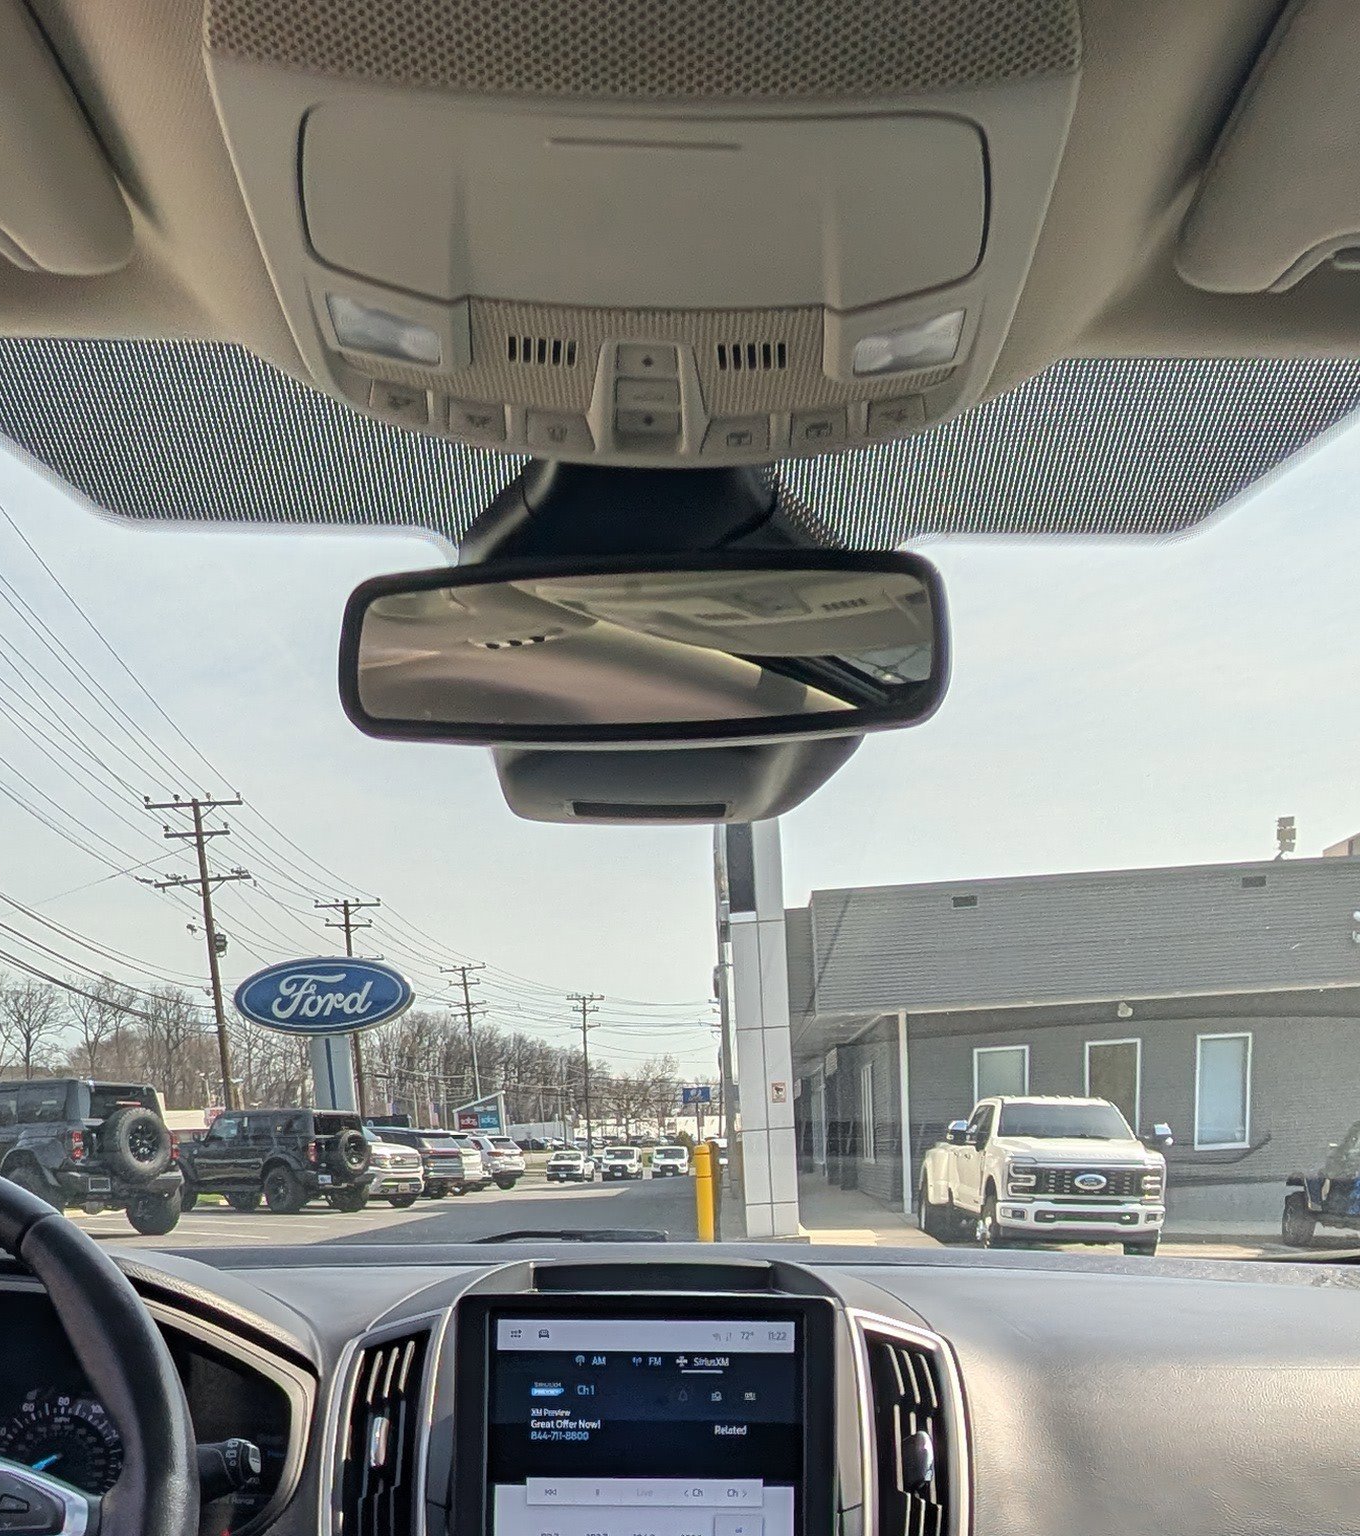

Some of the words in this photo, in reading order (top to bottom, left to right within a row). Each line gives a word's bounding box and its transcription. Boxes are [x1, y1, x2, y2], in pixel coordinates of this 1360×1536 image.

[271, 973, 374, 1019] Ford
[592, 1357, 606, 1366] AM
[649, 1357, 662, 1366] FM
[693, 1357, 730, 1366] SiriusXM
[22, 1403, 35, 1412] 60
[531, 1420, 554, 1429] Great
[556, 1420, 577, 1429] Offer
[714, 1425, 747, 1435] Related
